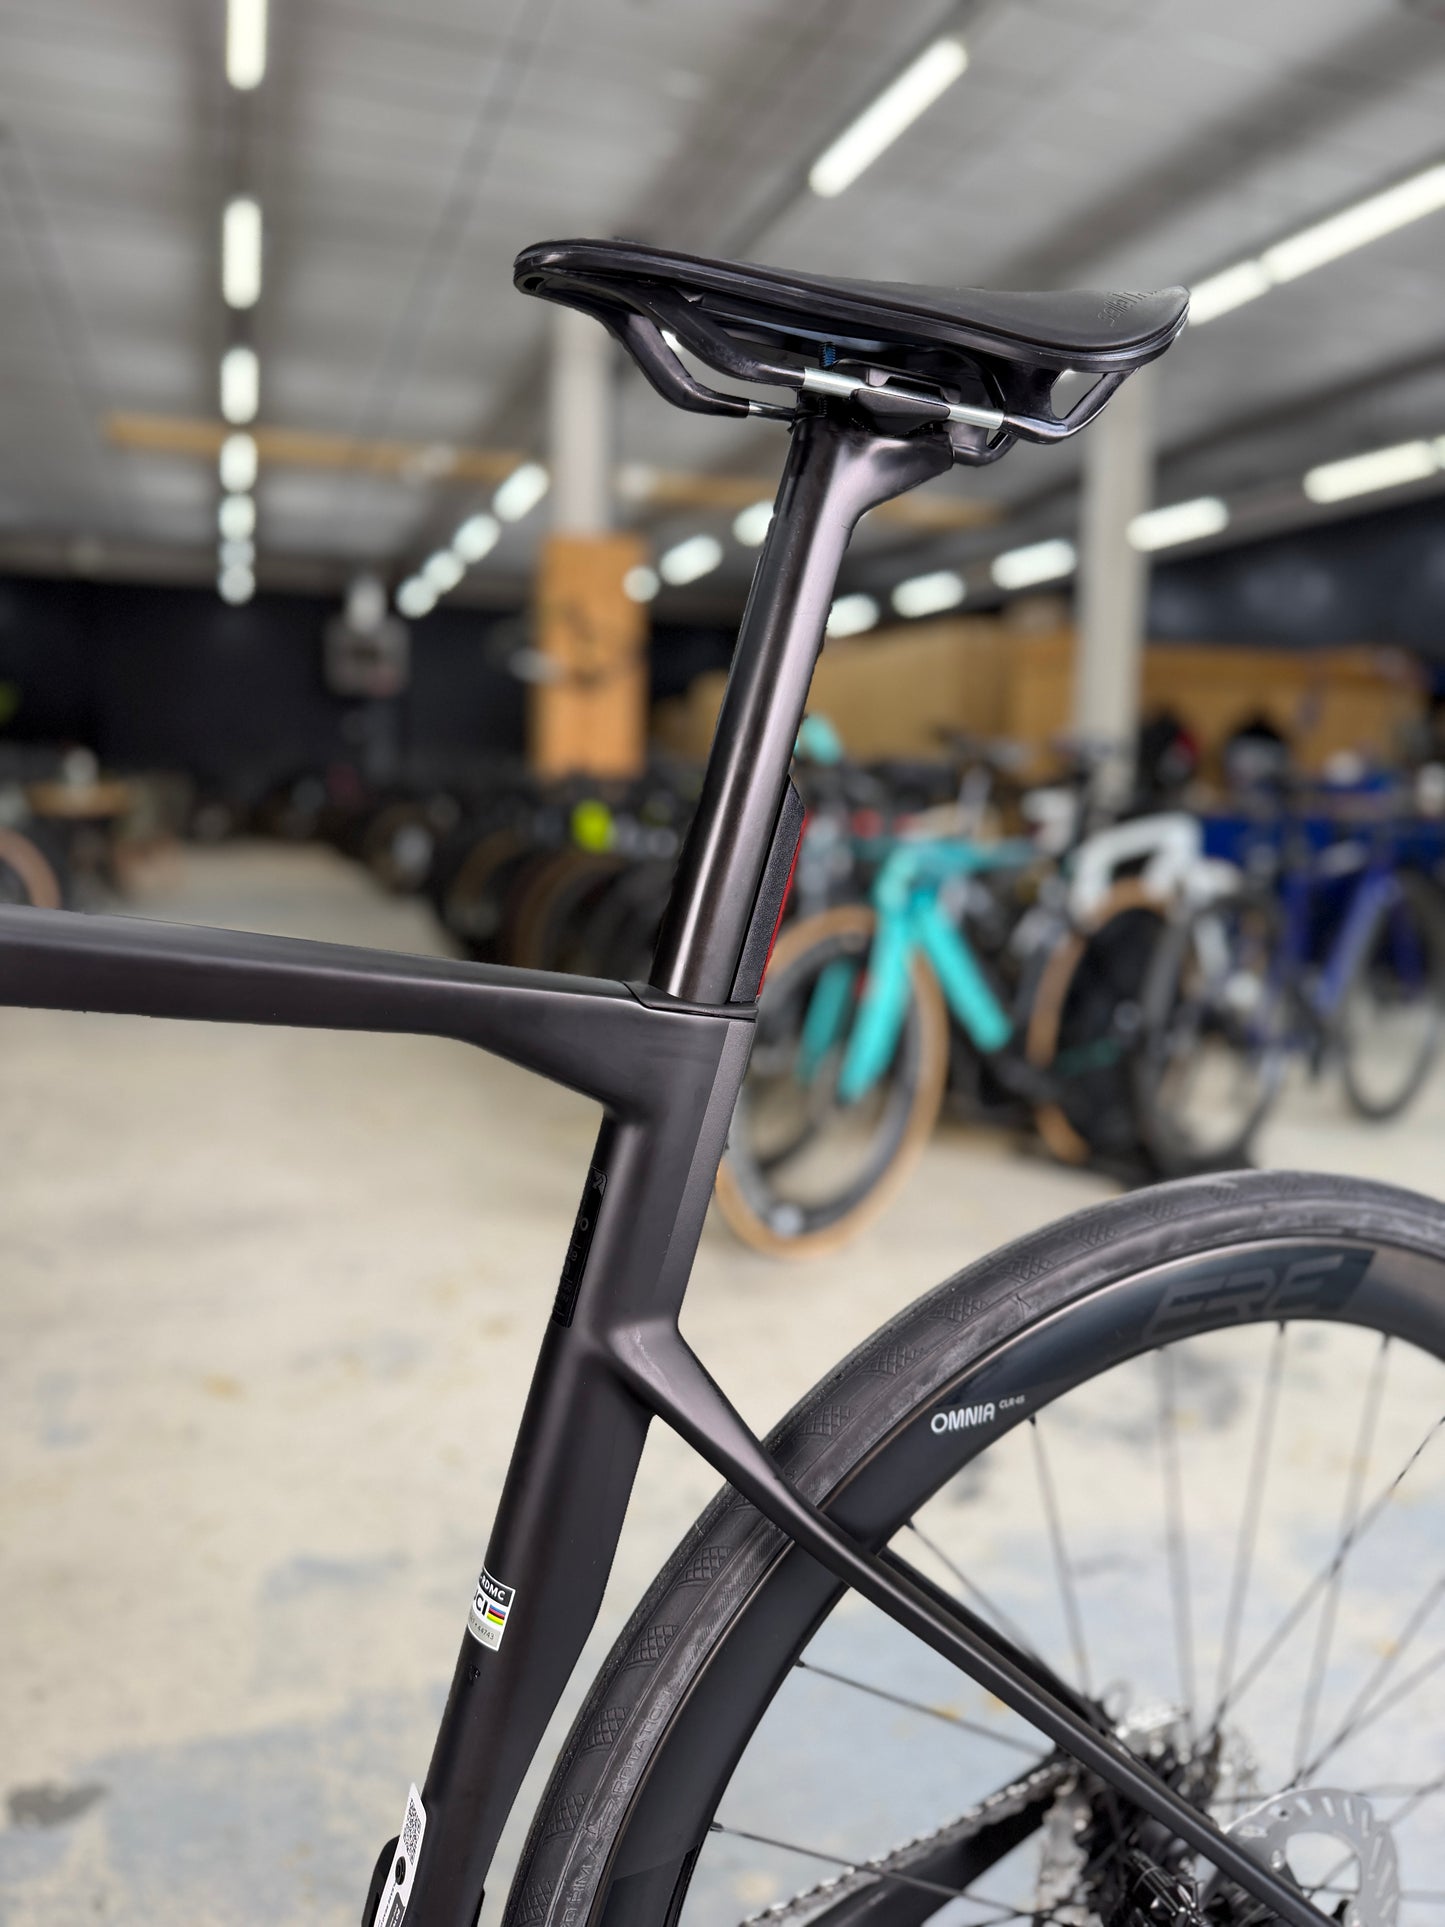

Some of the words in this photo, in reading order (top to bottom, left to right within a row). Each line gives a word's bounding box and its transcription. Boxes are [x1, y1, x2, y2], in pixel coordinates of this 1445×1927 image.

[1140, 1253, 1344, 1341] ERE
[930, 1402, 995, 1433] OMNIA
[474, 1590, 488, 1615] CI
